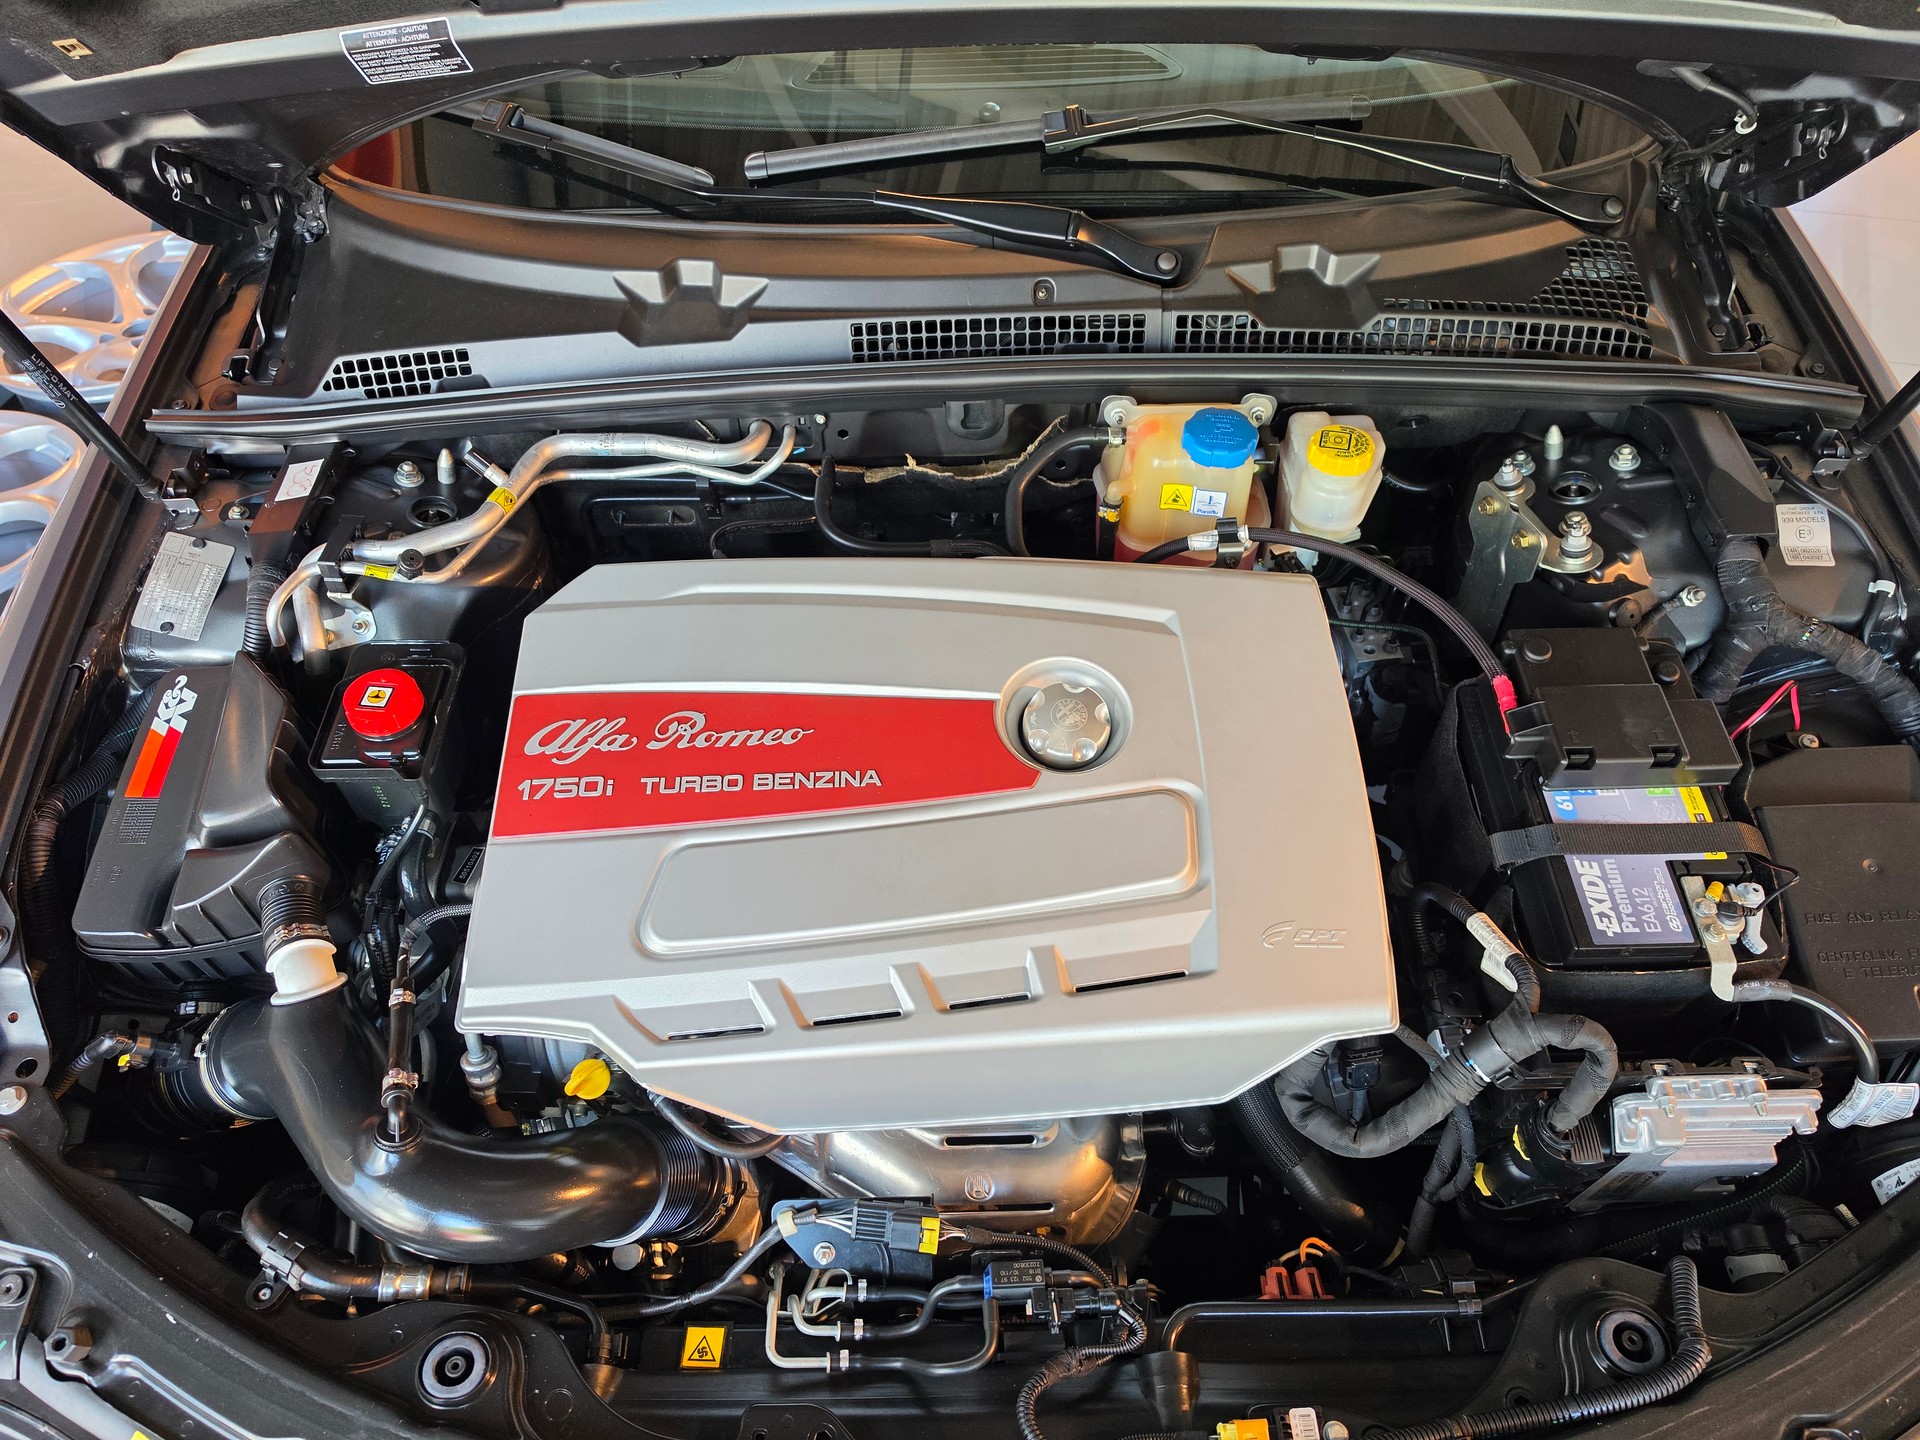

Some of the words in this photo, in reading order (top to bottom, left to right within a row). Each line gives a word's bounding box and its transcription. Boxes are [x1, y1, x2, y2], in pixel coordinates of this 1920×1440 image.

[362, 29, 398, 40] ATTENZIONE
[401, 24, 428, 34] CAUTION
[366, 38, 398, 48] ATTENTION
[401, 33, 430, 43] ACHTUNG
[150, 675, 198, 737] K&N
[524, 717, 637, 764] Alfa
[646, 710, 814, 750] Romeo
[517, 776, 614, 801] 1750i
[641, 774, 744, 795] TURBO
[753, 770, 883, 791] BENZINA
[1555, 795, 1574, 811] 61
[1575, 859, 1621, 937] EXIDE
[1606, 858, 1640, 933] Premium
[1632, 887, 1662, 933] EA612
[1654, 880, 1670, 914] carbon
[1662, 887, 1676, 916] boost
[1805, 912, 1840, 924] FUSE
[1847, 912, 1874, 923] AND
[1293, 928, 1348, 943] FPT
[1817, 950, 1902, 963] CENTRALINA
